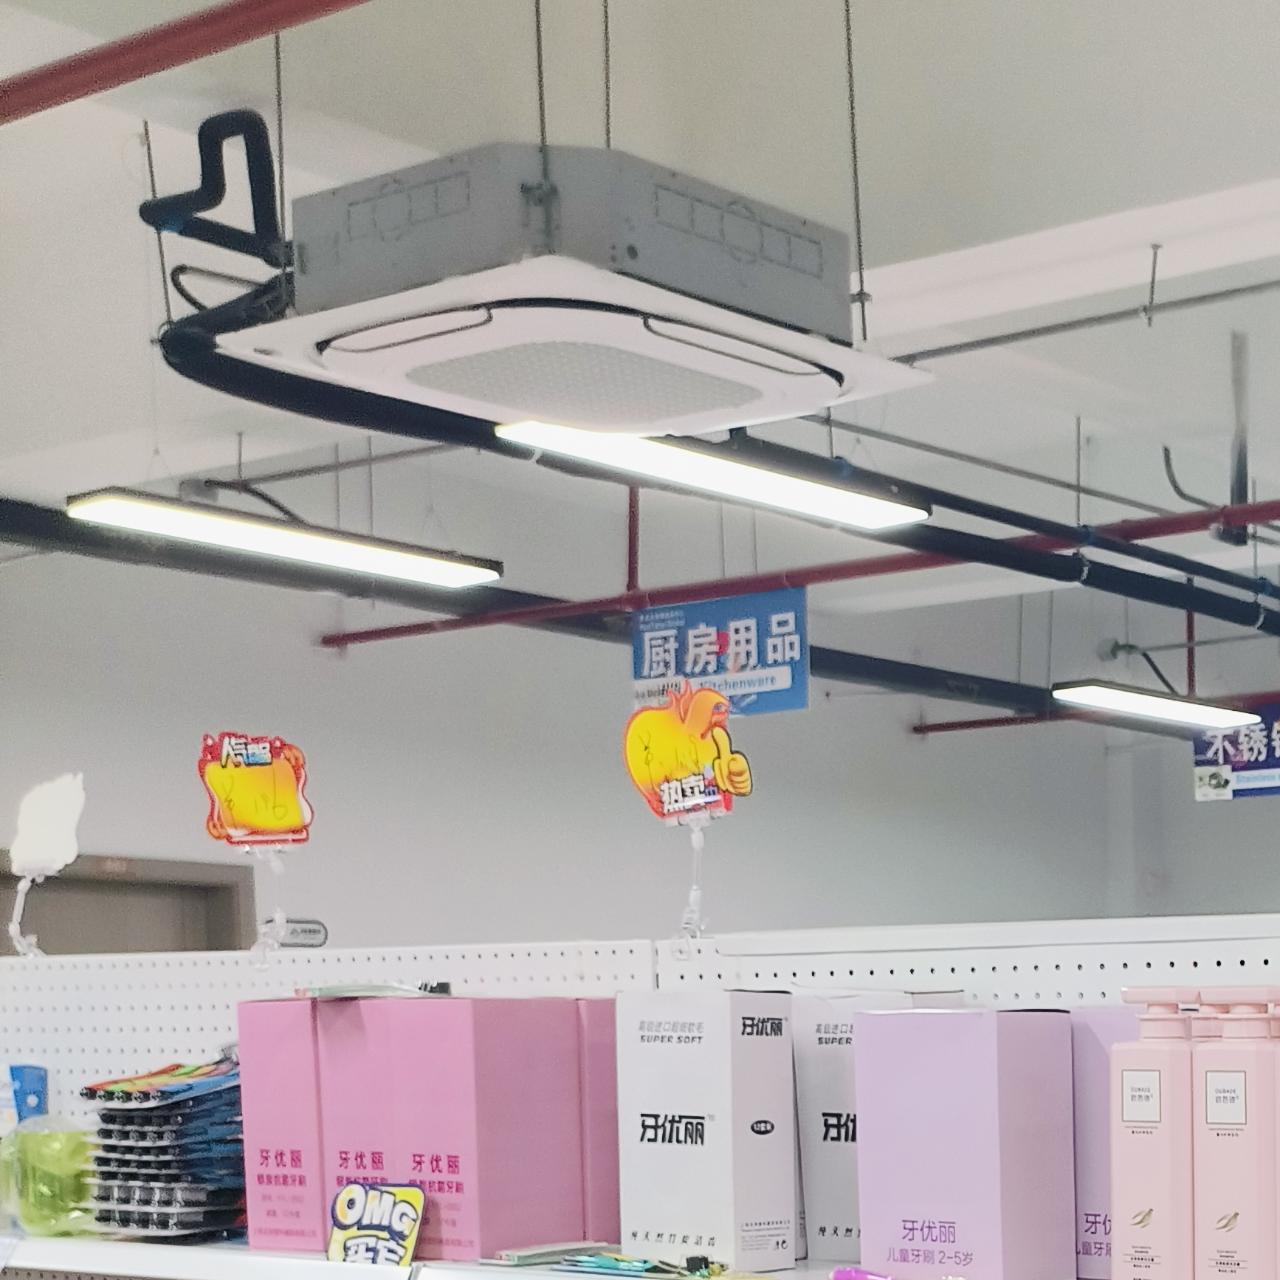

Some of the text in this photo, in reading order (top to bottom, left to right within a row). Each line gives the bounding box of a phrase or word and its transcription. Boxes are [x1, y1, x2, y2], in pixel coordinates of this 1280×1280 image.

[642, 611, 801, 676] 厨房用品
[640, 1034, 704, 1045] SUPER SOFT
[817, 1036, 853, 1046] SUPER
[640, 1112, 706, 1146] 牙优丽
[260, 1149, 303, 1170] 牙优丽
[338, 1150, 385, 1171] 牙优丽
[412, 1153, 461, 1176] 牙优丽
[335, 1183, 419, 1237] OMG
[901, 1219, 957, 1244] 牙优丽
[887, 1247, 973, 1267] 儿童牙刷 2-5岁
